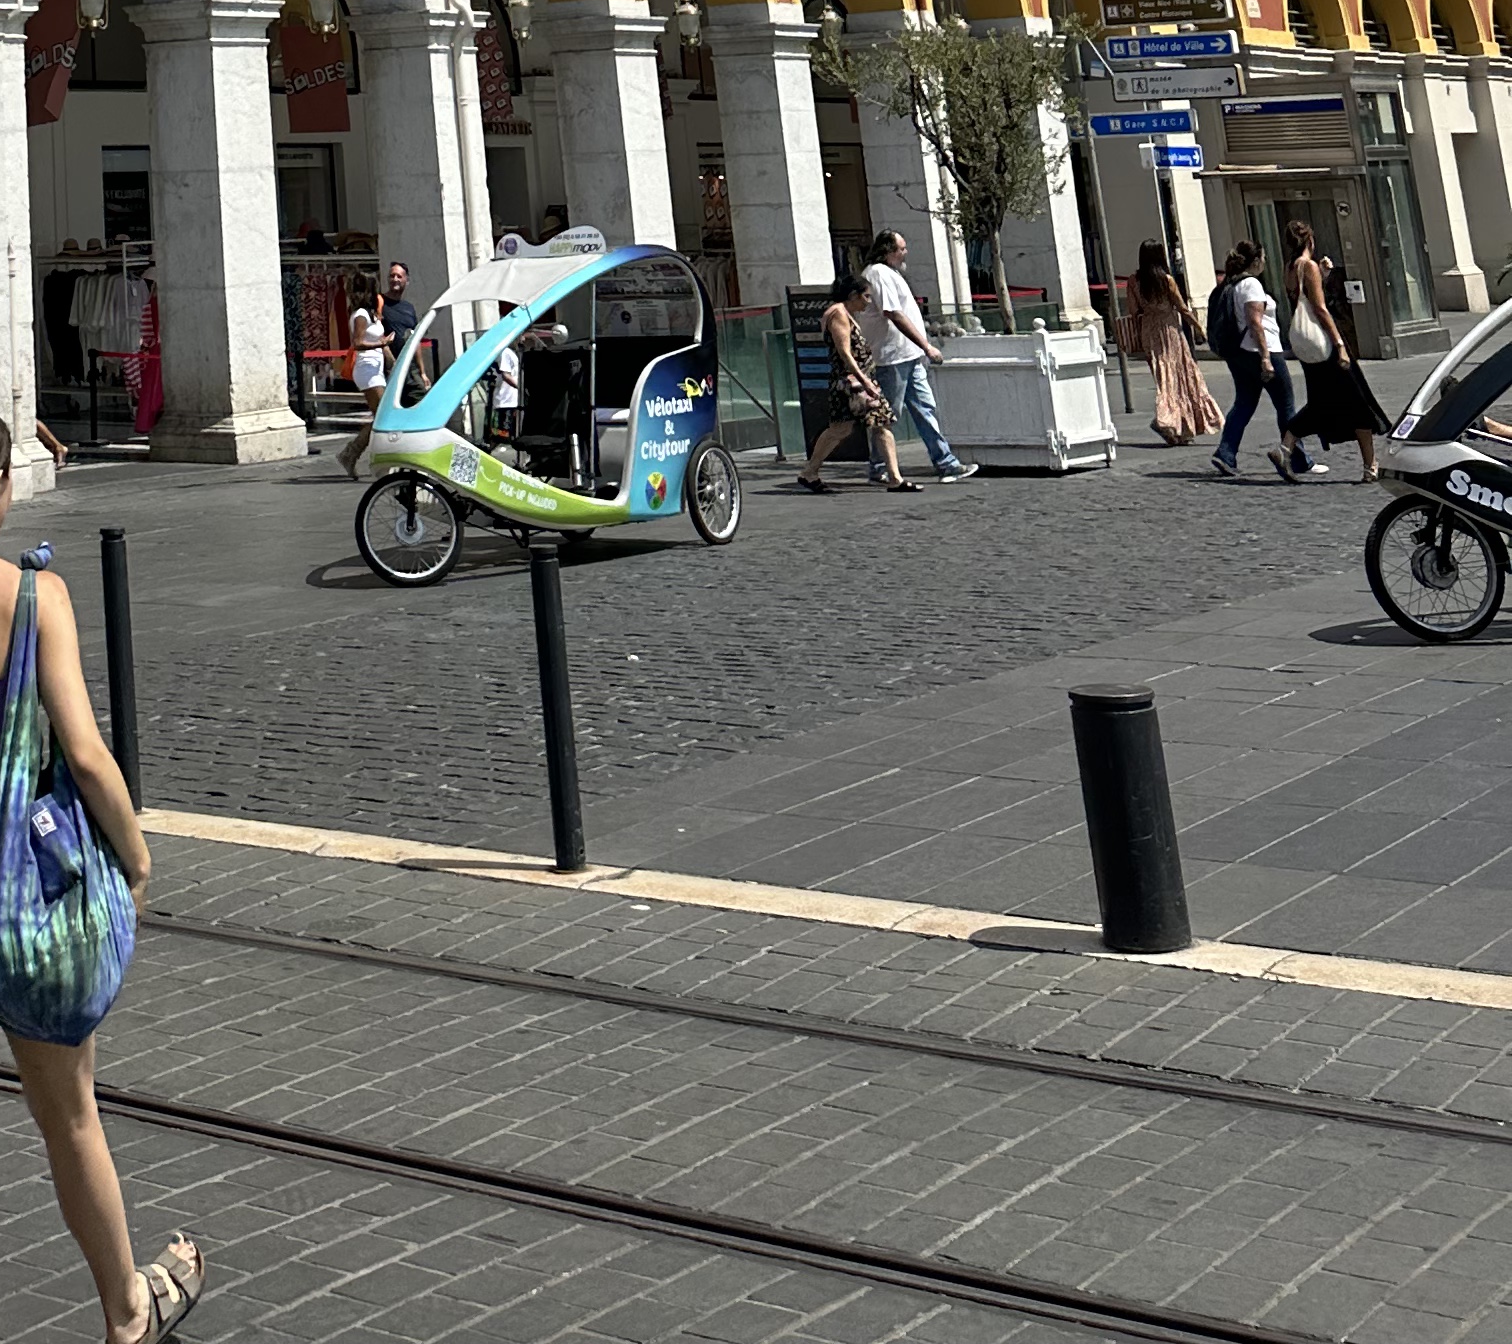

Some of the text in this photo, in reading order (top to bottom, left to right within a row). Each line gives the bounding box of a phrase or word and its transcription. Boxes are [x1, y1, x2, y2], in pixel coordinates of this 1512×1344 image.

[1144, 40, 1205, 53] Hôtel de Ville
[1124, 120, 1146, 129] Gare
[645, 395, 694, 418] Vélotaxi
[664, 419, 675, 436] &
[640, 437, 691, 462] Citytour
